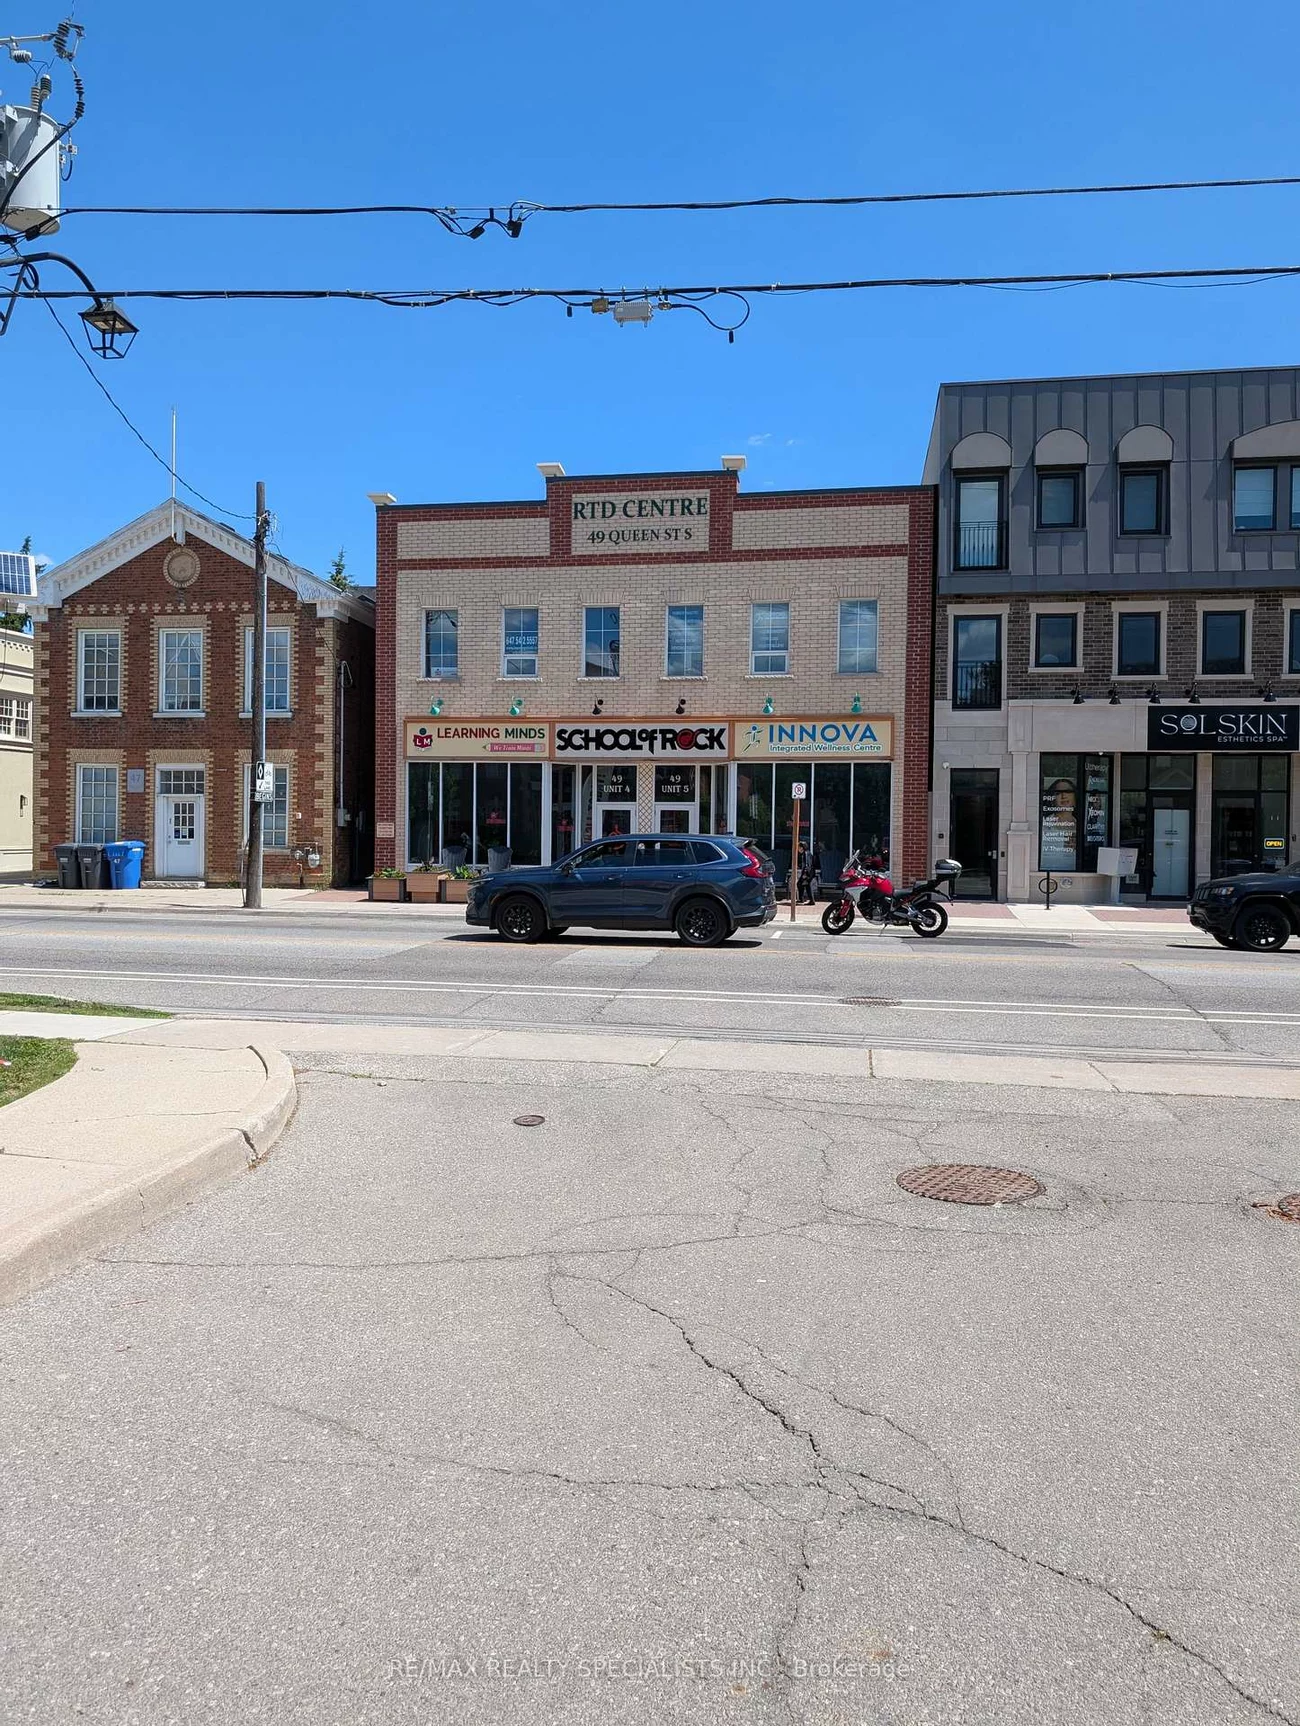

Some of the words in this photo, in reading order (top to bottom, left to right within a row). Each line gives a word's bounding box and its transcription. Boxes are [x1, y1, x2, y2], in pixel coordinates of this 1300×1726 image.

[573, 501, 617, 519] RTD
[622, 497, 708, 518] CENTRE
[587, 530, 606, 544] 49
[608, 529, 660, 545] QUEEN
[664, 527, 681, 541] ST
[684, 527, 693, 540] S
[437, 727, 500, 739] LEARNING
[504, 727, 546, 739] MINDS
[769, 723, 878, 743] INNOVA
[556, 728, 643, 751] SCHOOL
[658, 728, 726, 751] ROCK
[770, 744, 812, 753] Integrated
[814, 743, 850, 751] Wellness
[853, 743, 882, 751] Centre
[611, 775, 623, 783] 49
[669, 775, 681, 783] 49
[603, 785, 623, 793] UNIT
[624, 785, 630, 793] 4
[661, 785, 681, 793] UNIT
[683, 785, 689, 793] 5
